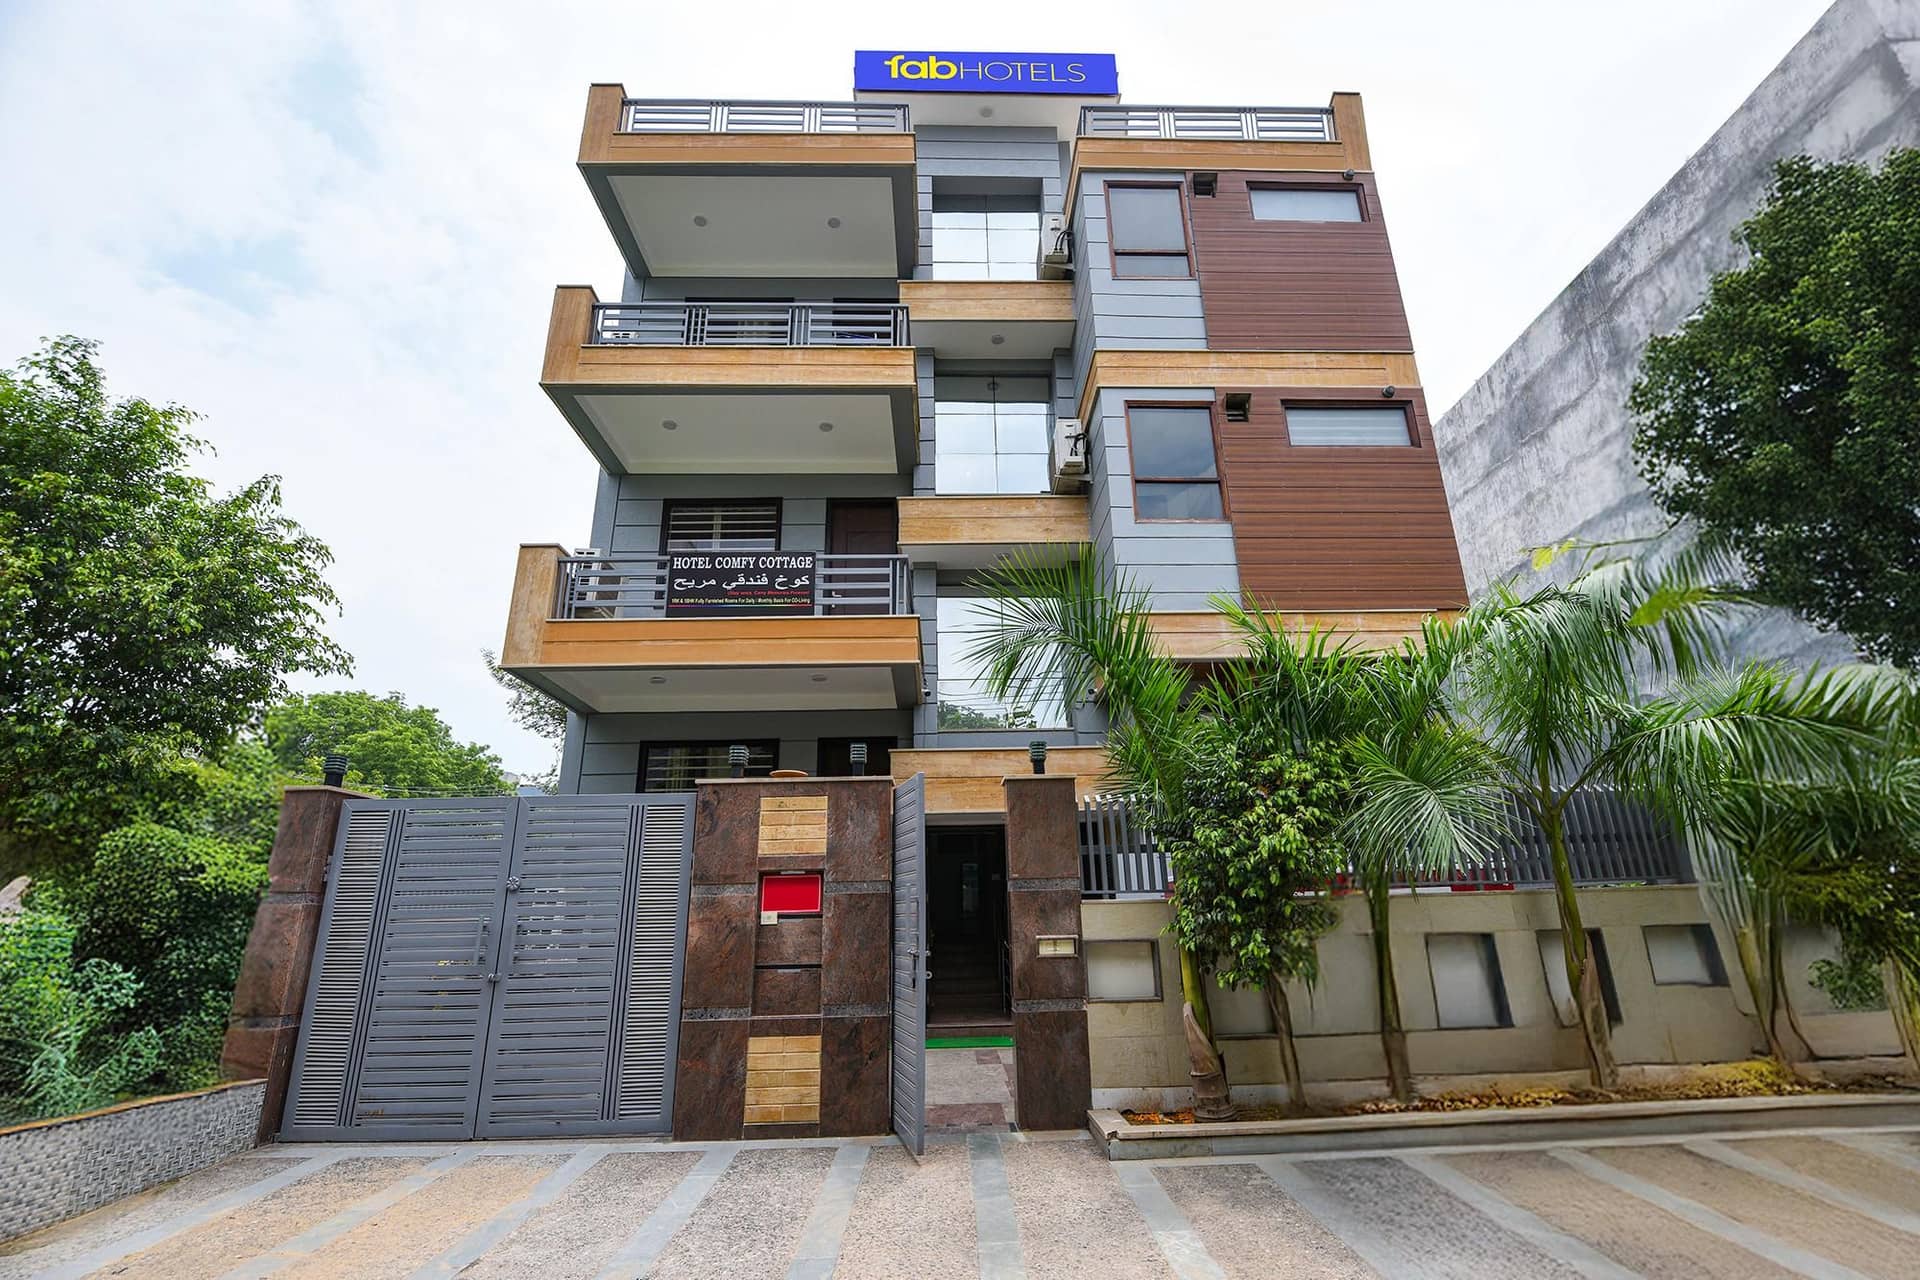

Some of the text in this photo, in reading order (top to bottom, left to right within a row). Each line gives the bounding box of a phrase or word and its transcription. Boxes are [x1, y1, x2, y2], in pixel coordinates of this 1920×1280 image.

[673, 556, 813, 569] HOTEL COMFY COTTAGE
[673, 573, 810, 590] كوخ فندقي مريح
